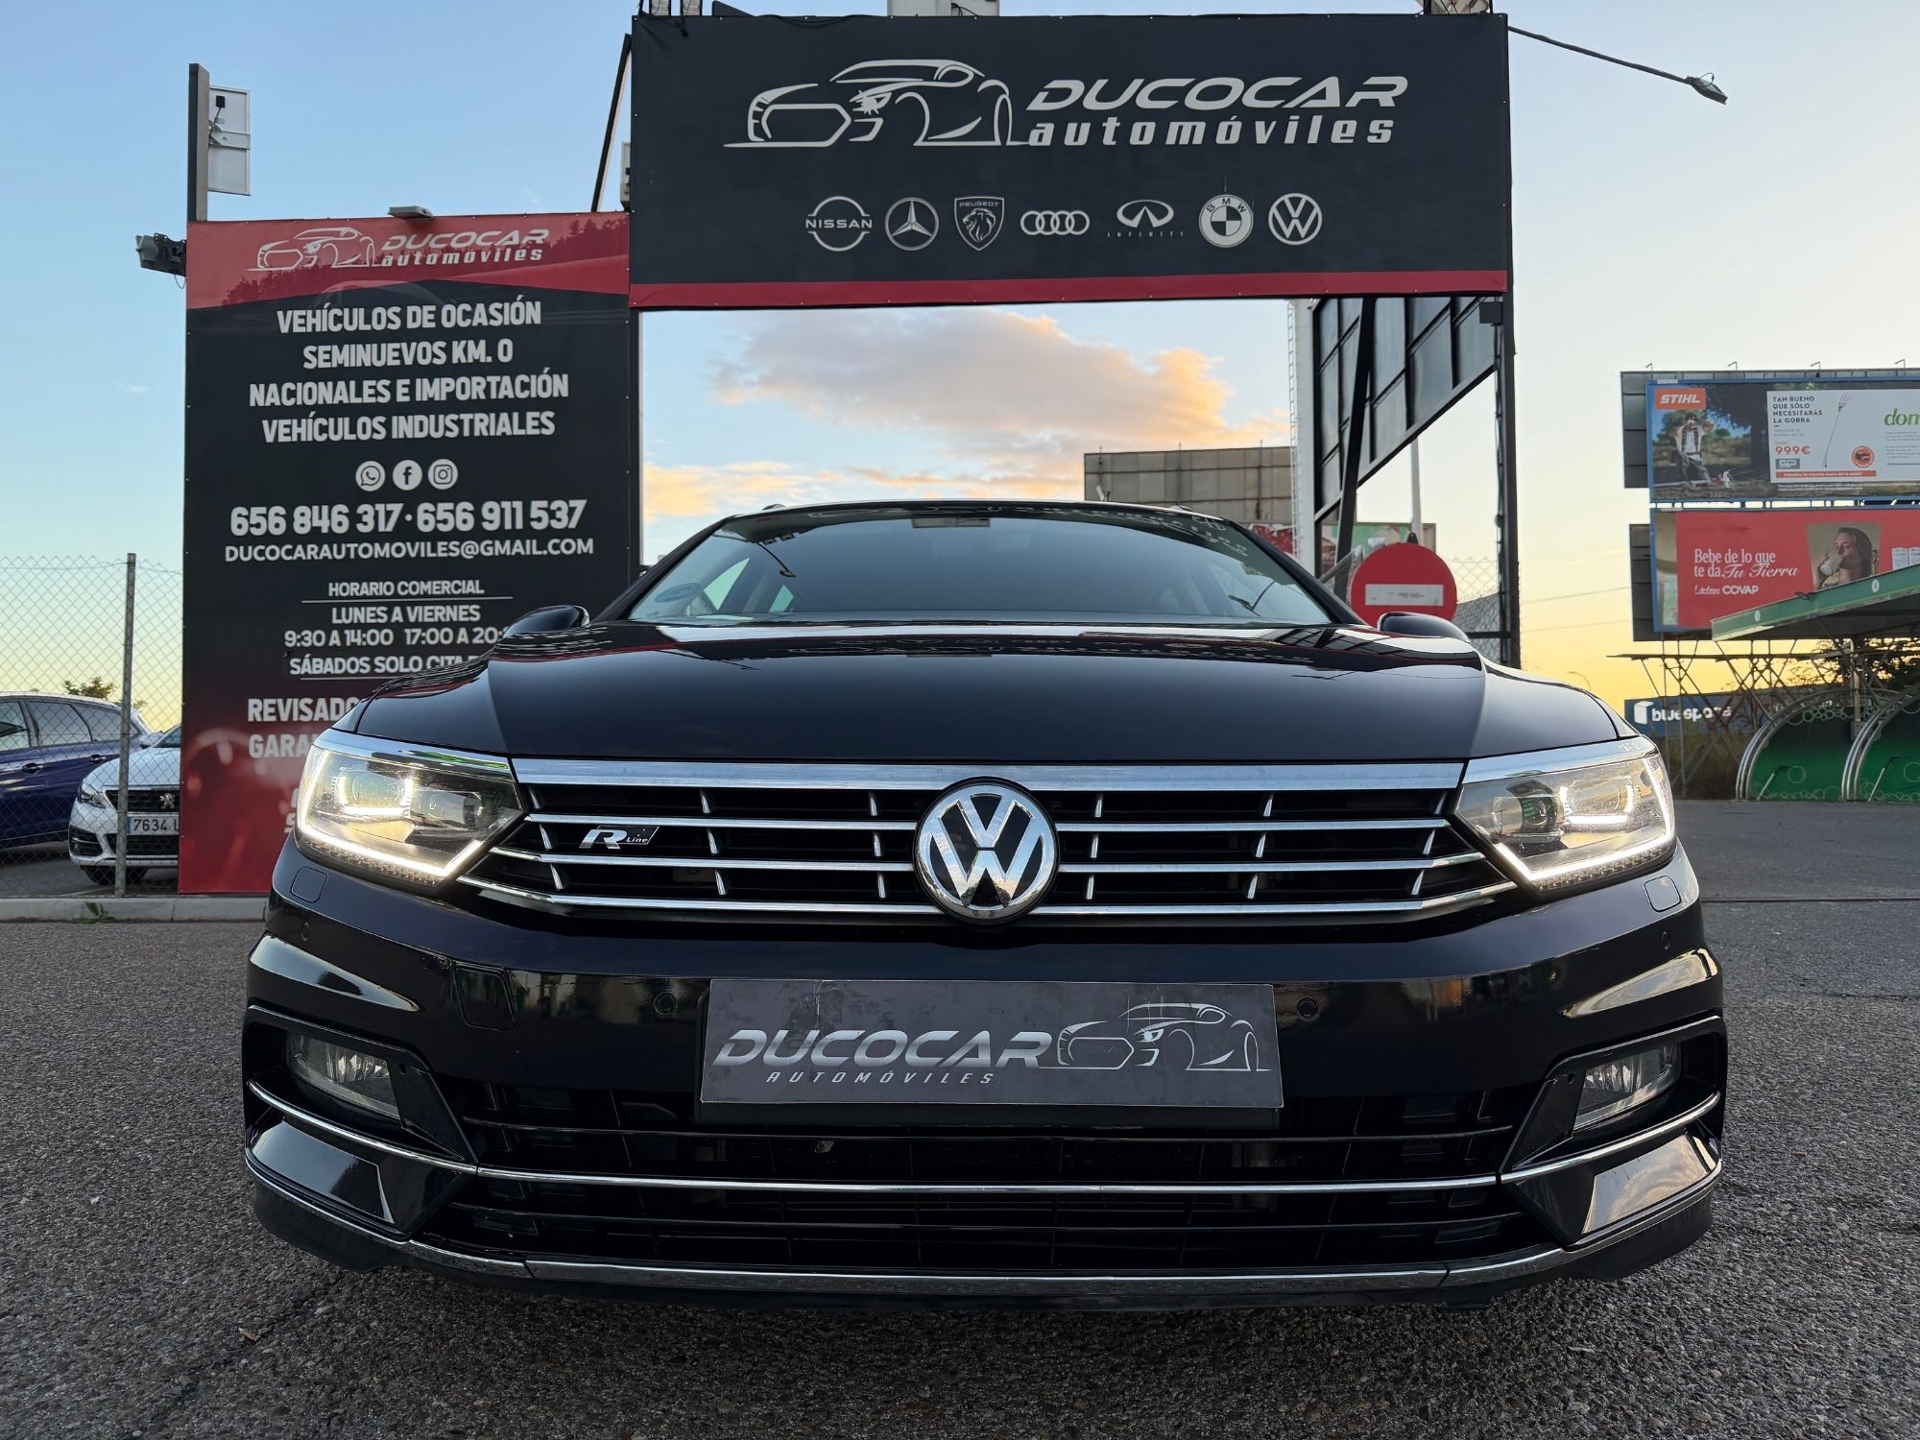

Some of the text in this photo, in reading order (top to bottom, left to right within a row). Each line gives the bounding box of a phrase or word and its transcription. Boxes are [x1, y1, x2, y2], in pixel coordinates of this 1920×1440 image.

[1026, 75, 1409, 111] DUCOCAR
[1027, 115, 1395, 147] automóviles
[1206, 196, 1247, 213] BMW
[805, 218, 873, 229] NISSAN
[381, 229, 549, 250] DUCOCAR
[277, 295, 542, 333] VEHÍCULOS DE OCASIÓN
[303, 341, 447, 369] SEMINUEVOS
[452, 340, 493, 364] KM.
[249, 367, 569, 407] NACIONALES E IMPORTACIÓN
[1660, 394, 1701, 404] STIHL
[262, 411, 556, 443] VEHÍCULOS INDUSTRIALES
[1775, 445, 1811, 455] 999€
[230, 506, 287, 536] 656
[293, 504, 349, 534] 846
[481, 501, 523, 530] 911
[530, 499, 588, 529] 537
[225, 538, 594, 562] DUCOCARAUTOMOVILES@GMAIL.COM
[1694, 548, 1776, 566] Bebe de lo que
[1694, 562, 1800, 578] te da Tu Tierra
[328, 579, 485, 597] HORARIO COMERCIAL
[1722, 584, 1759, 595] COVAP
[332, 604, 480, 624] LUNES A VIERNES
[284, 631, 325, 647] 9:30
[328, 630, 341, 646] A
[344, 629, 394, 646] 14:00
[404, 627, 454, 645] 17:00
[457, 627, 469, 644] A
[289, 653, 371, 675] SÁBADOS
[374, 656, 422, 674] SOLO
[133, 818, 167, 832] 7634
[579, 828, 648, 850] R Line
[712, 1030, 1052, 1068] DUCOCAR
[766, 1068, 995, 1085] AUTOMÓVILES
